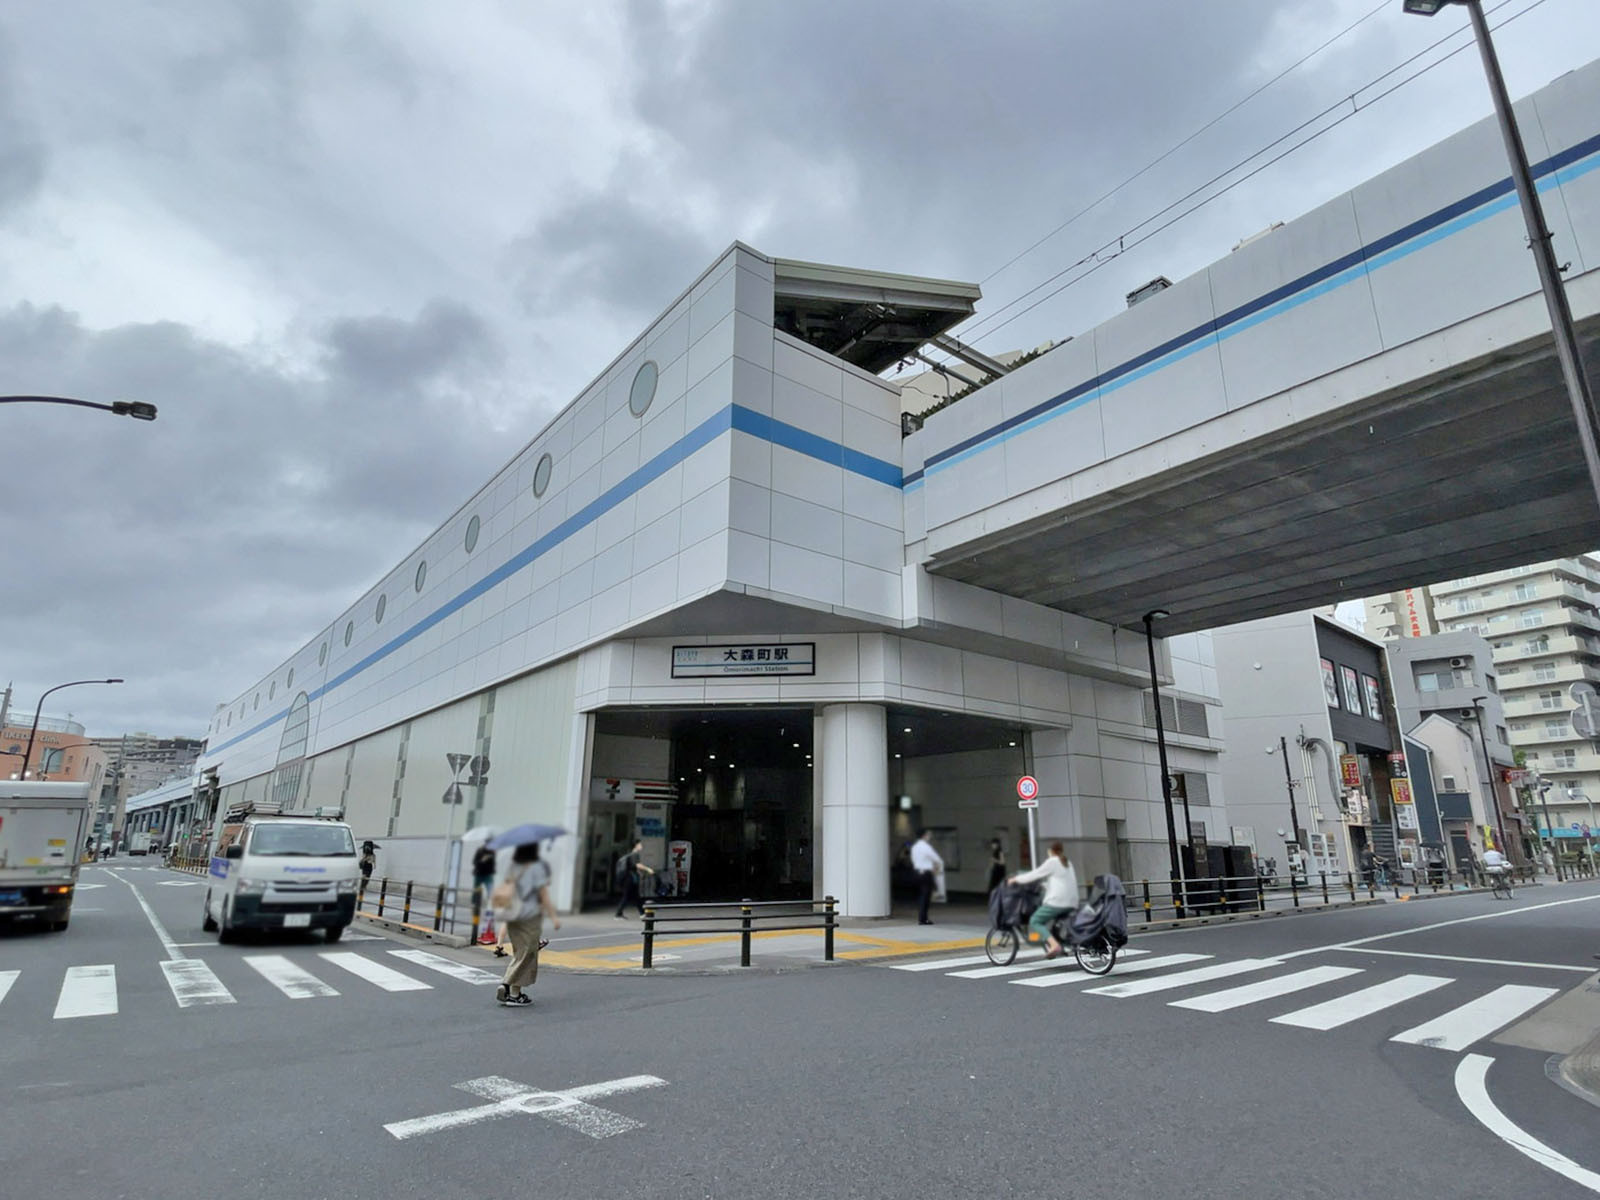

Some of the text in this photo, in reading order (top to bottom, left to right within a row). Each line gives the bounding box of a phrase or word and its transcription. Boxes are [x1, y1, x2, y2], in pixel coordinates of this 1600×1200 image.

[723, 648, 789, 662] 大森町駅
[1022, 783, 1033, 793] 30
